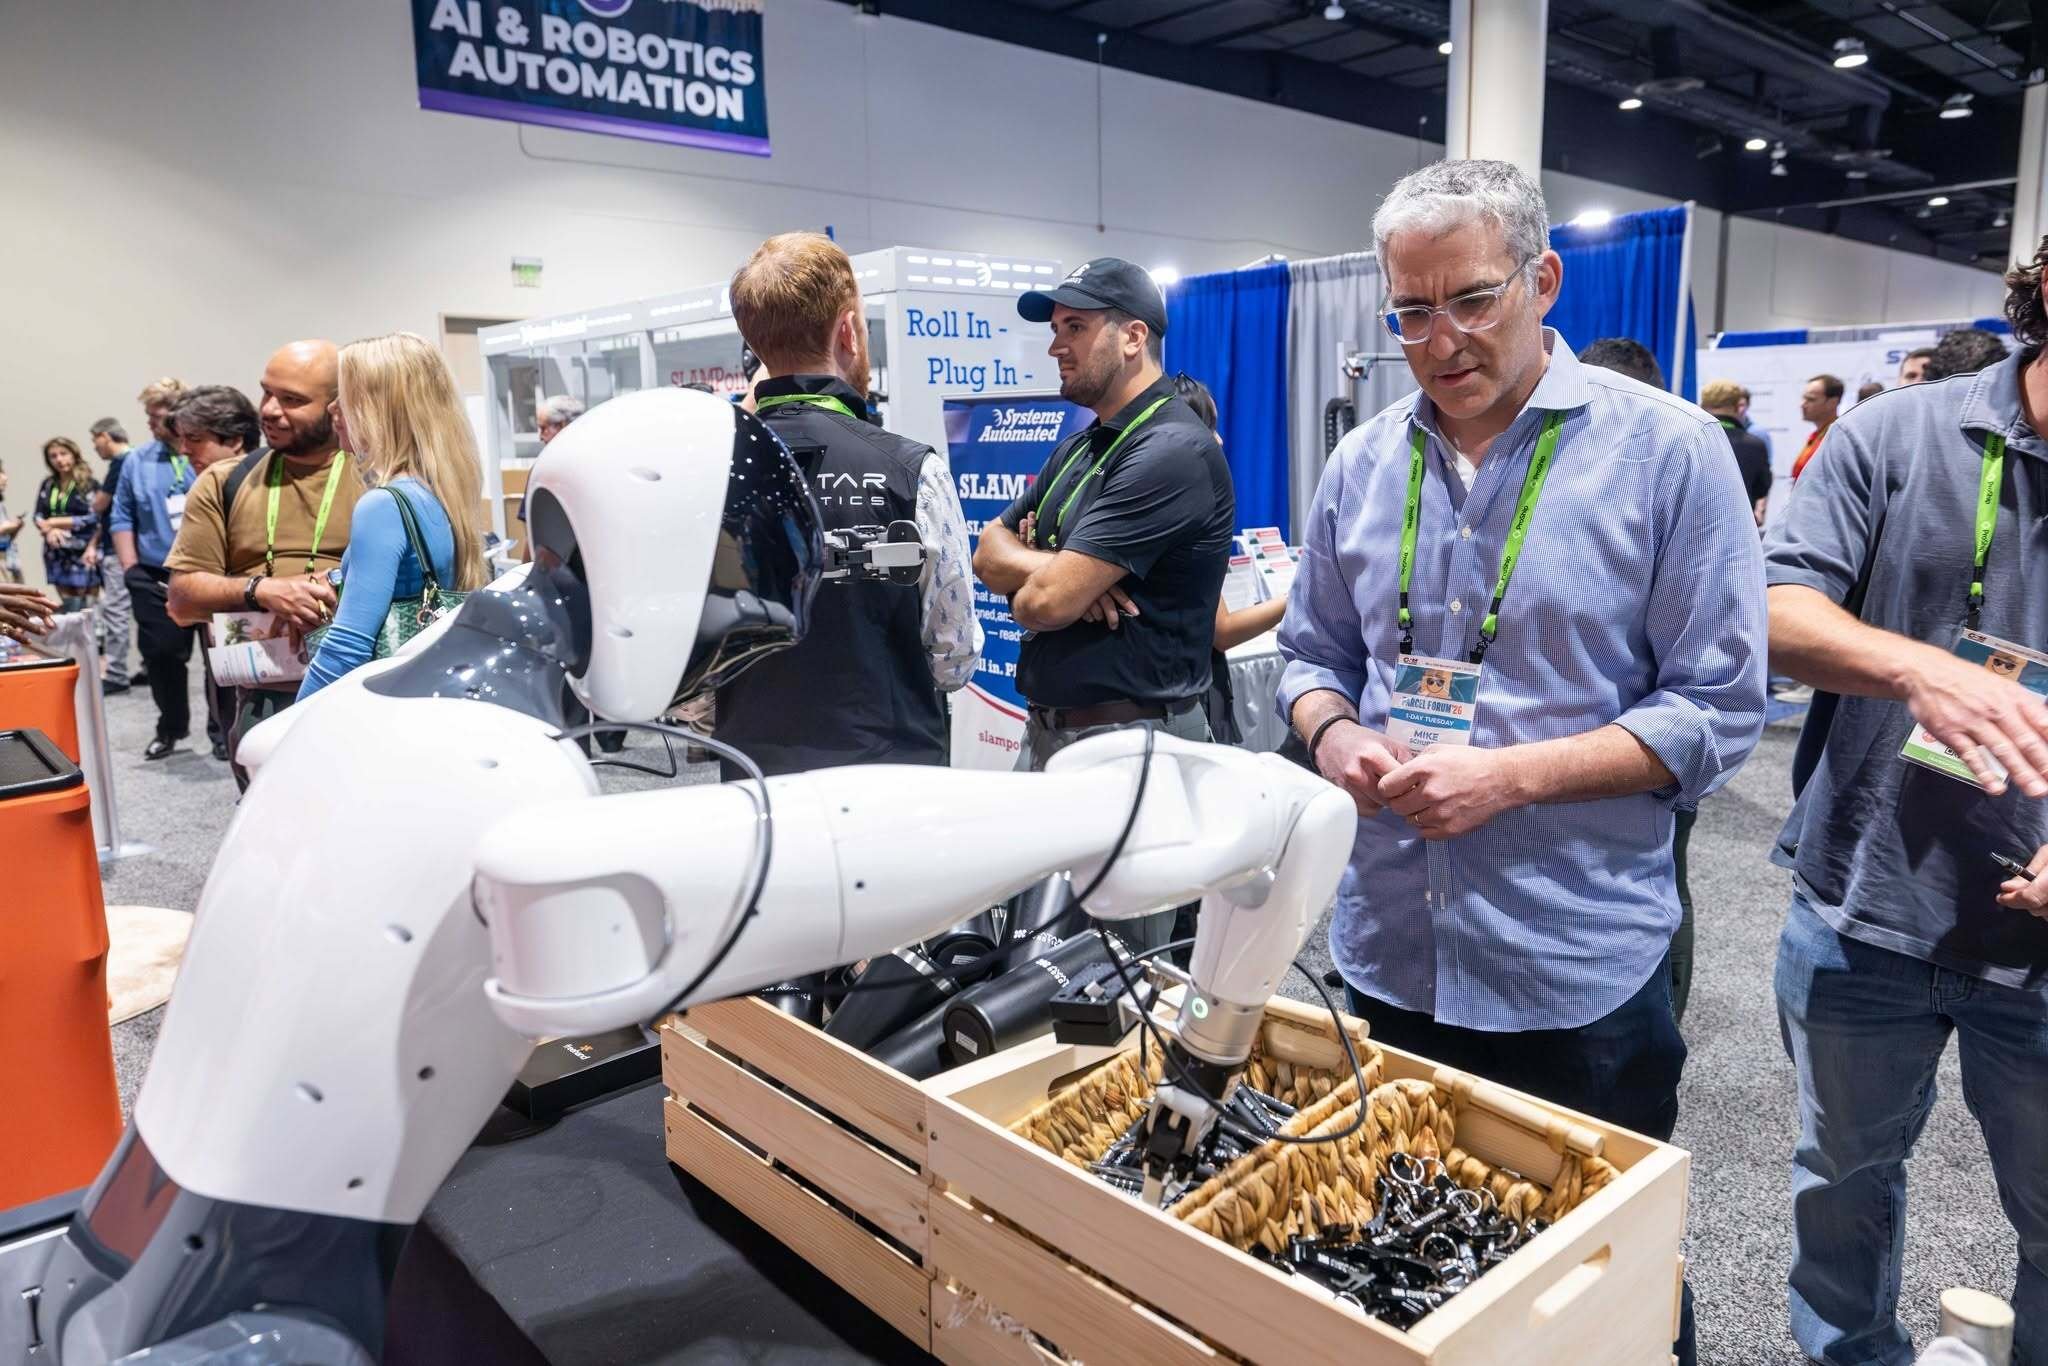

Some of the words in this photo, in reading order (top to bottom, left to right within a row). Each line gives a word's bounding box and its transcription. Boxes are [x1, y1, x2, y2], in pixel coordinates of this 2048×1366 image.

[429, 0, 483, 38] AI
[495, 7, 531, 46] &
[540, 14, 756, 86] ROBOTICS
[448, 40, 745, 122] AUTOMATION
[906, 309, 960, 338] Roll
[966, 311, 992, 339] In
[927, 357, 986, 393] Plug
[993, 359, 1018, 385] In
[1002, 408, 1066, 429] Systems
[977, 424, 1060, 443] Automated
[1534, 455, 1547, 480] ProShip
[816, 472, 887, 489] TAR
[819, 495, 885, 506] TICS
[1985, 481, 1994, 505] ProShip
[1407, 505, 1415, 529] ProShip
[1515, 505, 1529, 531] ProShip
[1978, 529, 1990, 553] ProShip
[1501, 555, 1512, 580] ProShip
[999, 629, 1022, 642] read
[1405, 712, 1425, 721] 1-DAY
[1425, 715, 1455, 726] TUESDAY
[978, 730, 1020, 752] slampo
[1414, 730, 1440, 741] MIKE
